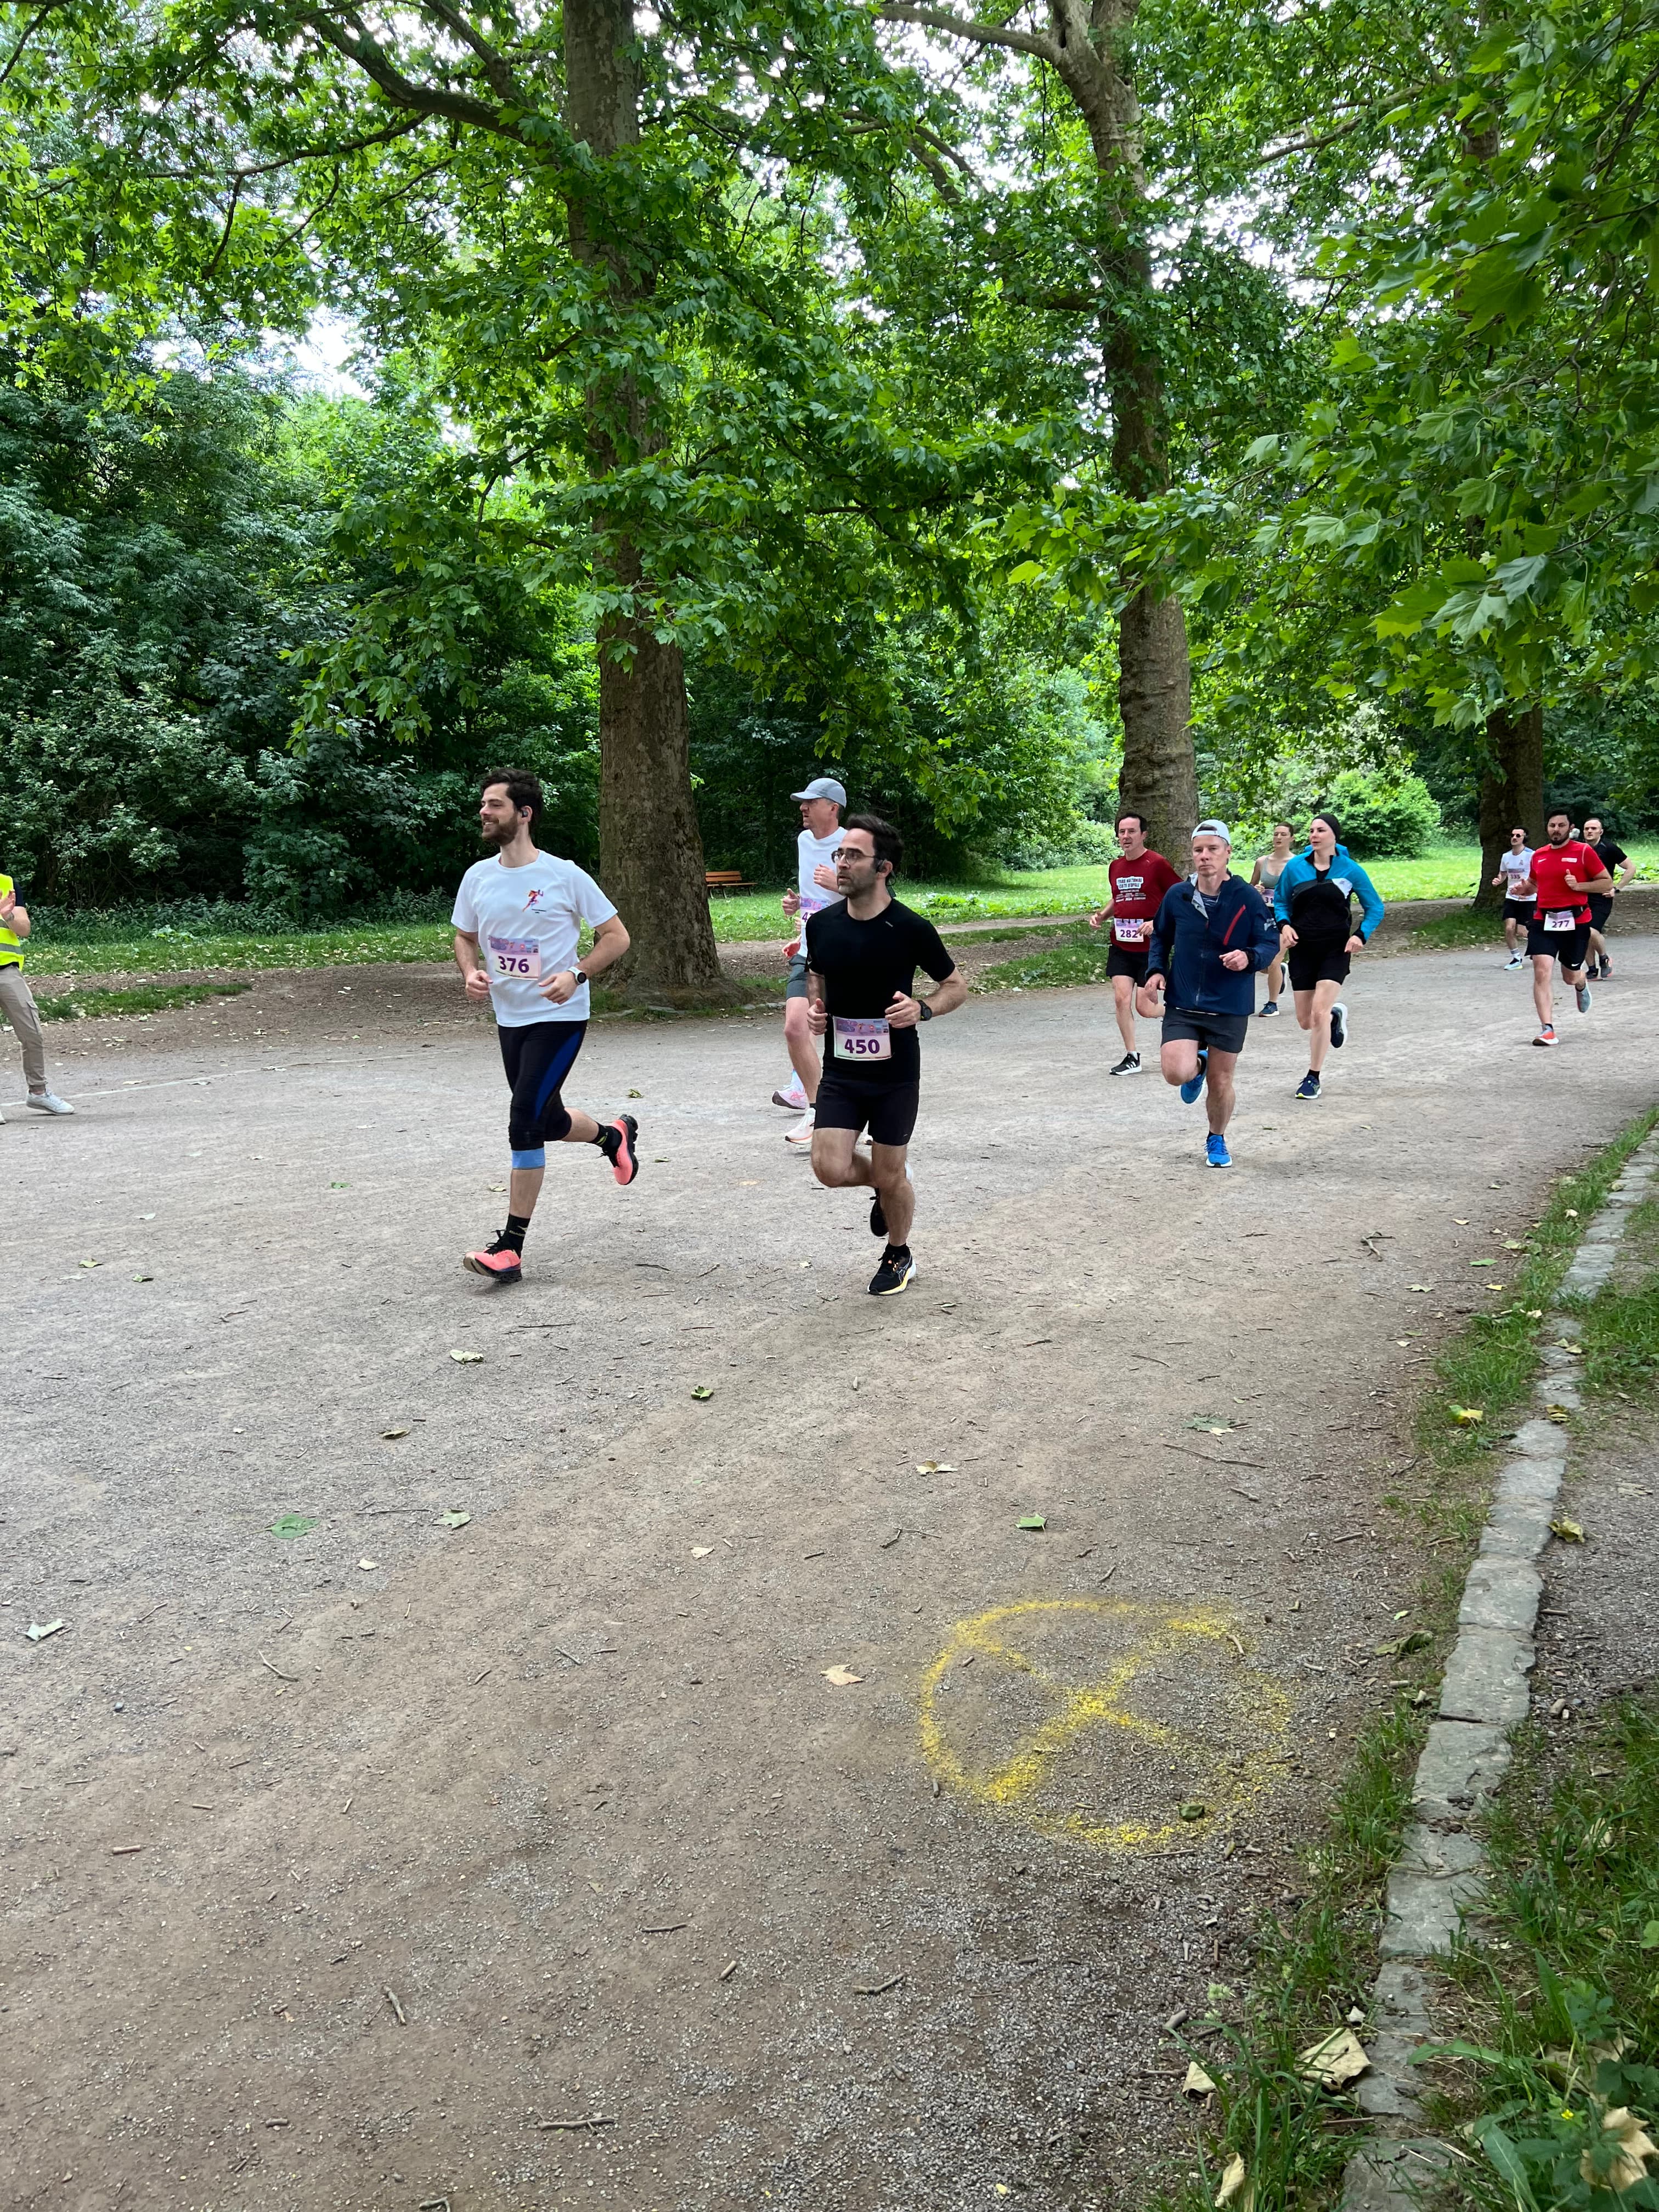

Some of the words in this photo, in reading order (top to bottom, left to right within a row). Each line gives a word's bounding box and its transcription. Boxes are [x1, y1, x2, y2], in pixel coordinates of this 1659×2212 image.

[802, 912, 815, 923] 4
[1551, 920, 1570, 928] 277
[1120, 929, 1138, 938] 282
[498, 956, 529, 973] 376
[844, 1039, 880, 1054] 450
